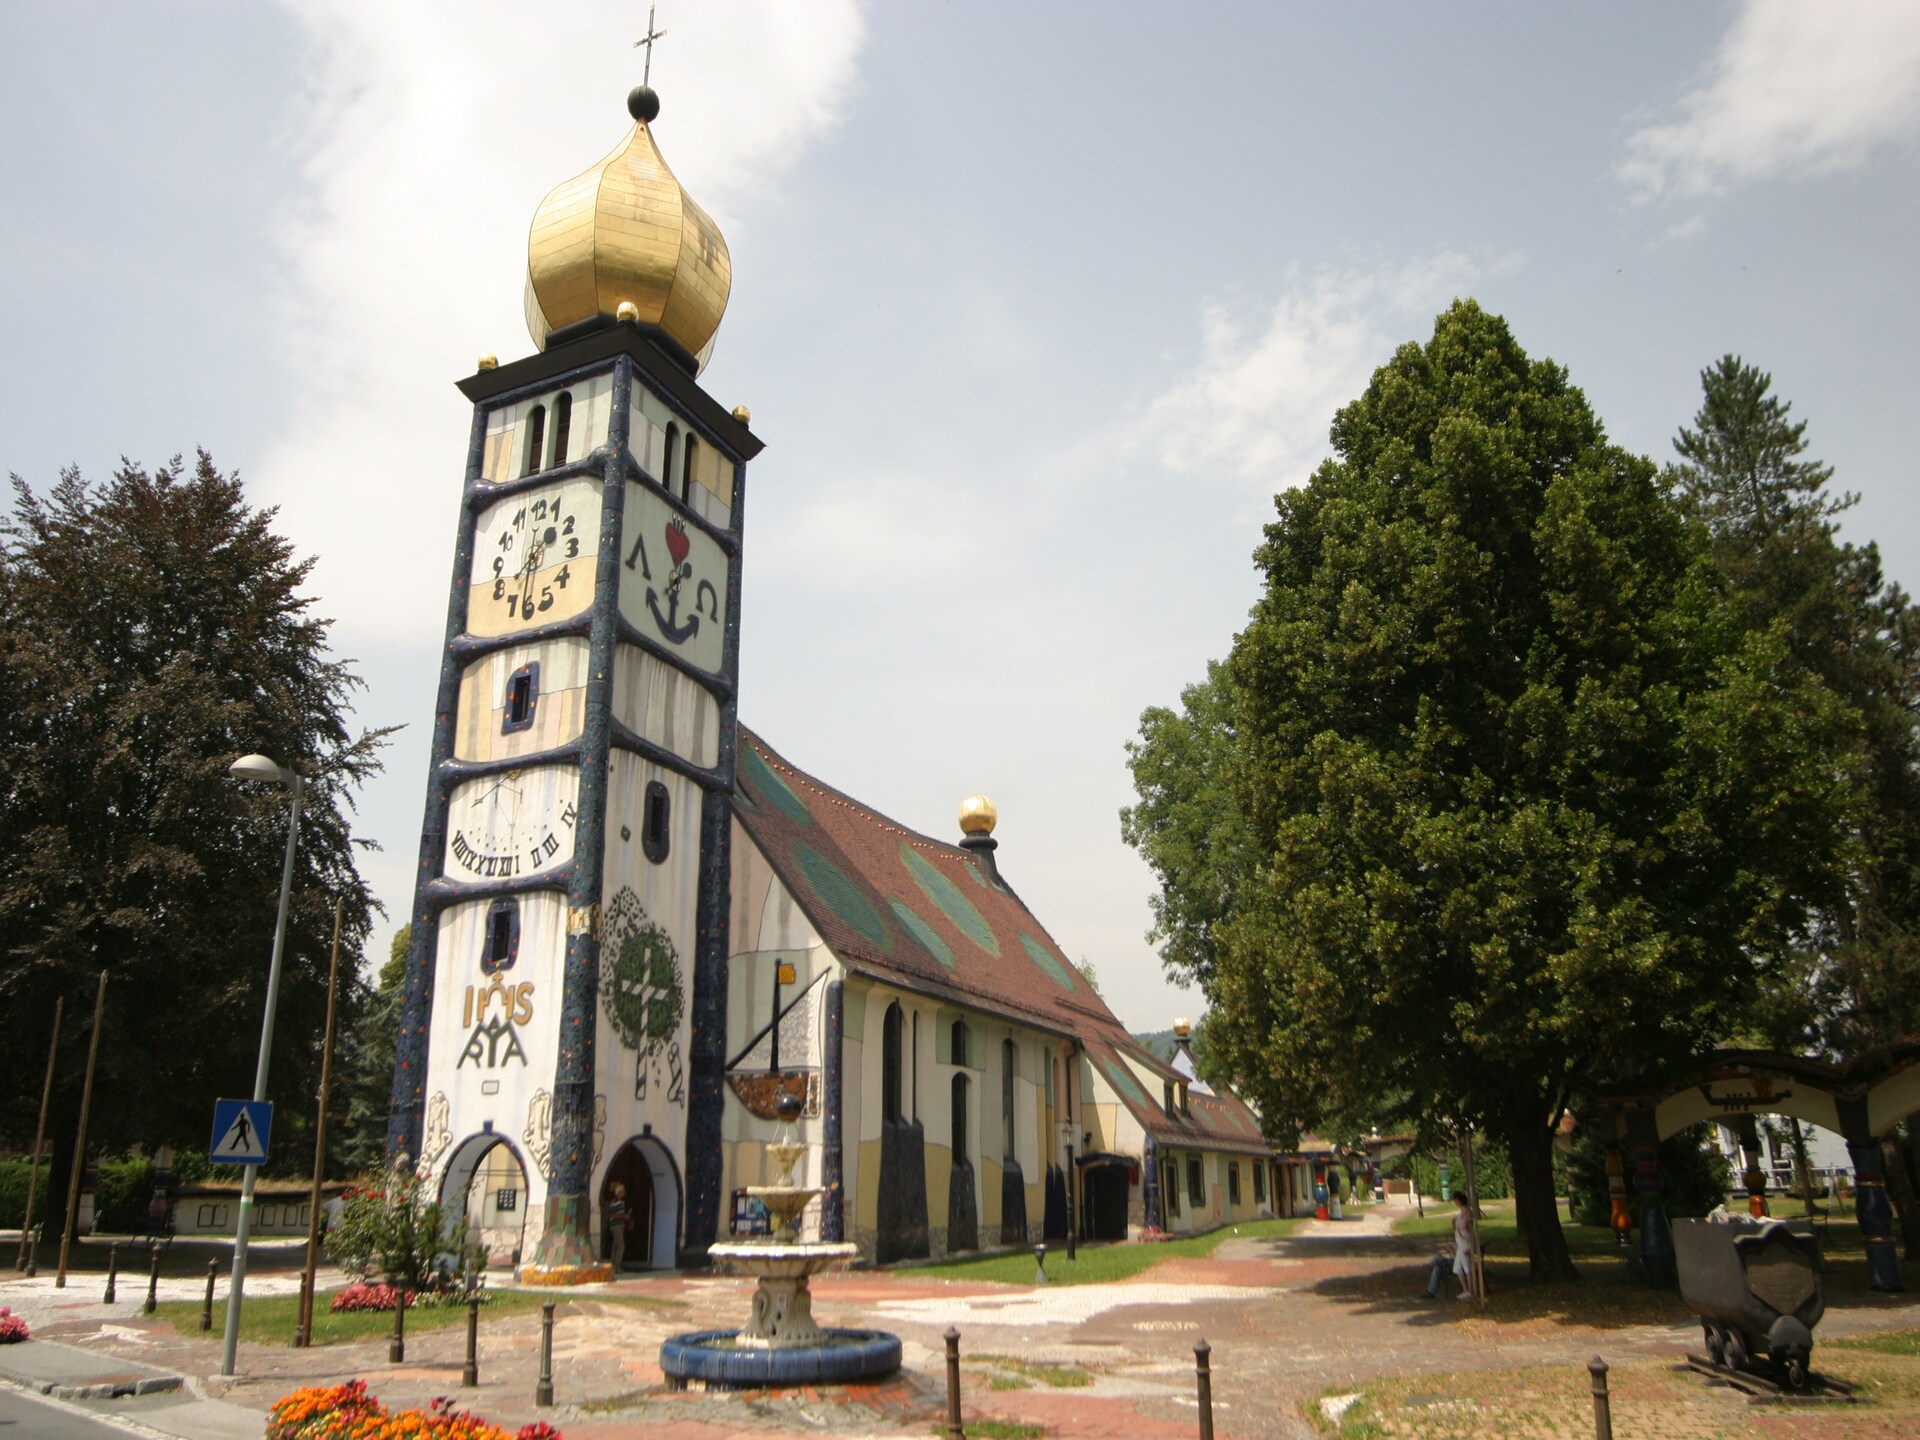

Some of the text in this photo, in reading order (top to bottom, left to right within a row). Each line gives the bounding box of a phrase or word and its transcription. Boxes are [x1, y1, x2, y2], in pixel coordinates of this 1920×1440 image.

[512, 507, 527, 534] 11
[530, 499, 547, 521] 12
[549, 495, 561, 523] 1
[562, 515, 575, 536] 2
[498, 531, 513, 552] 10
[564, 537, 579, 558] 3
[493, 556, 504, 579] 9
[553, 564, 570, 589] 4
[493, 579, 505, 601] 8
[537, 585, 554, 612] 5
[507, 594, 519, 618] 7
[522, 595, 535, 620] 6
[560, 802, 577, 829] IV
[530, 847, 542, 869] II
